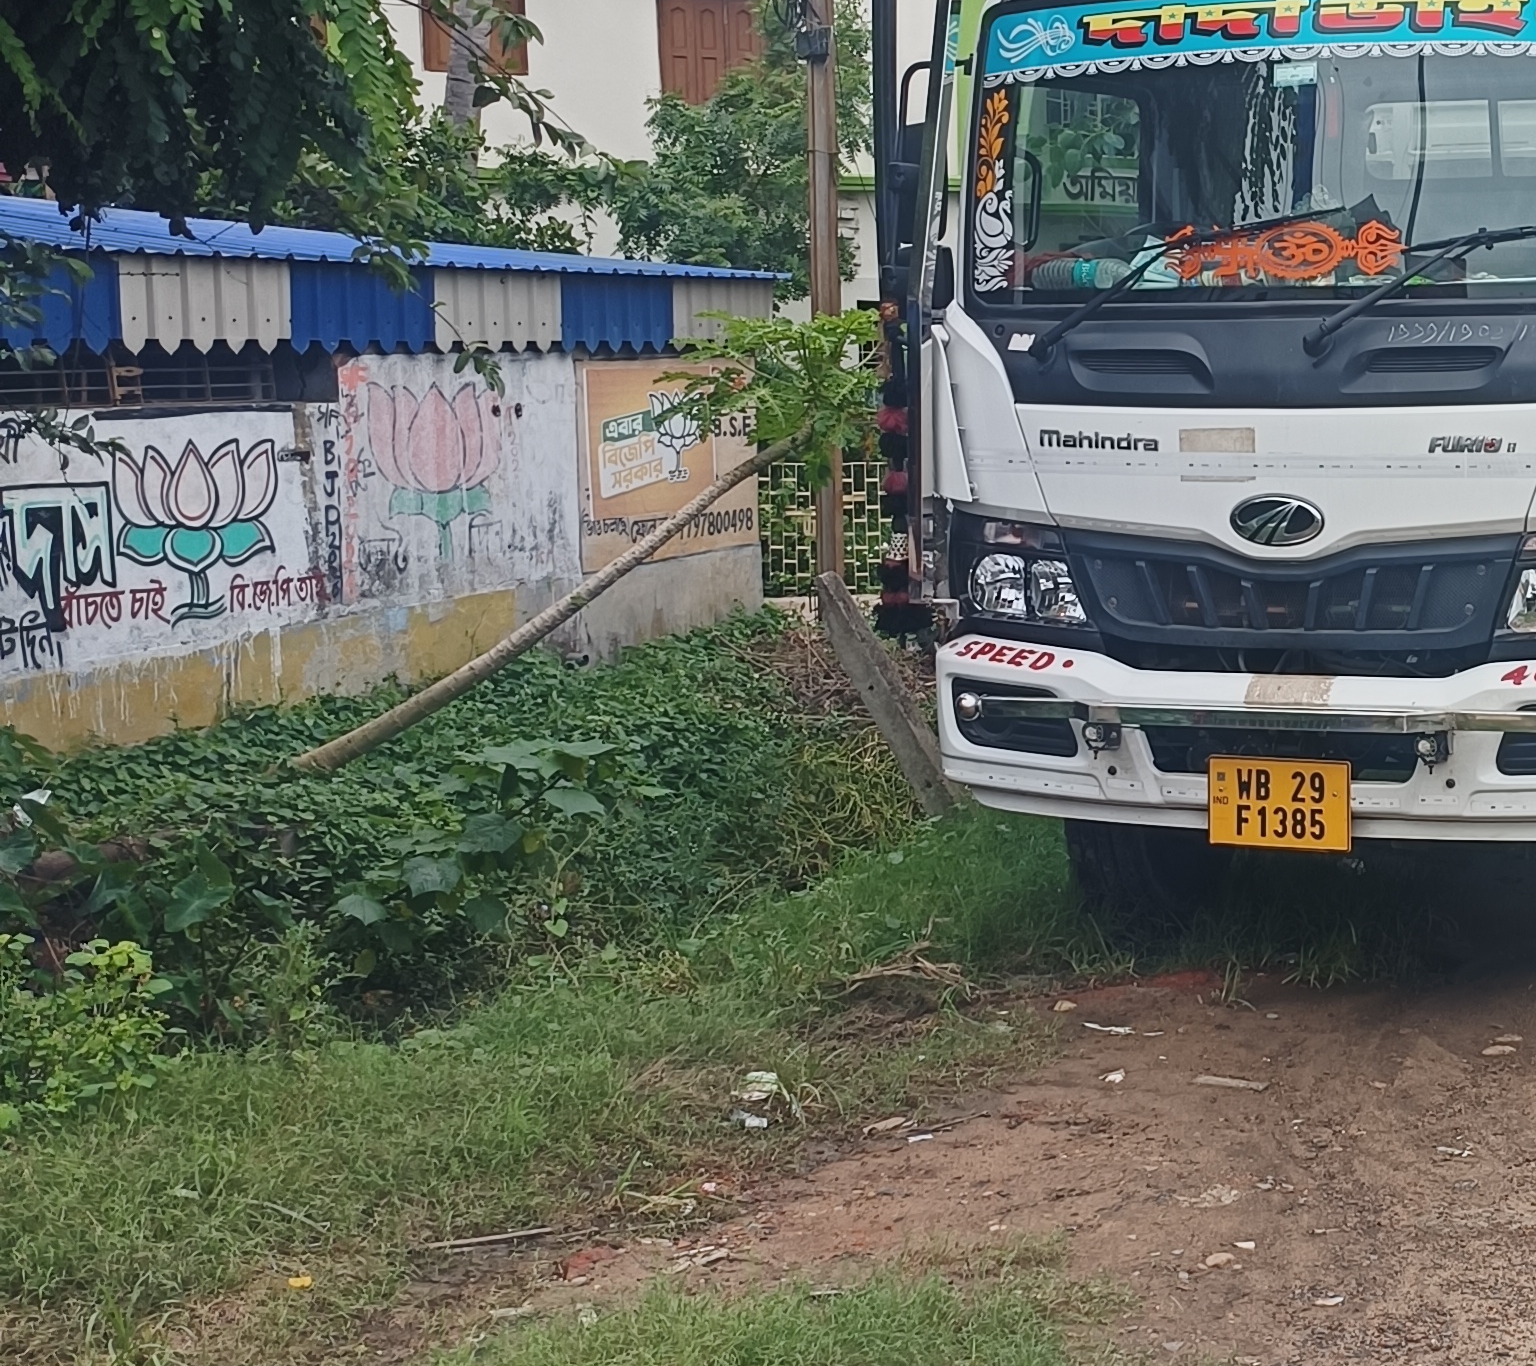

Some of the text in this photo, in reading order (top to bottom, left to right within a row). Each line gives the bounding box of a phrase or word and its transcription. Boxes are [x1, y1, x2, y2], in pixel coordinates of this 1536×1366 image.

[605, 412, 644, 439] এবার
[602, 434, 656, 470] বিজেপি
[1427, 435, 1503, 454] FURIO
[611, 456, 664, 489] সরকার
[129, 579, 171, 625] চাই
[955, 640, 1056, 671] SPEED
[1212, 795, 1229, 805] IND
[1236, 768, 1325, 804] WB 29
[1236, 804, 1326, 841] F1385
